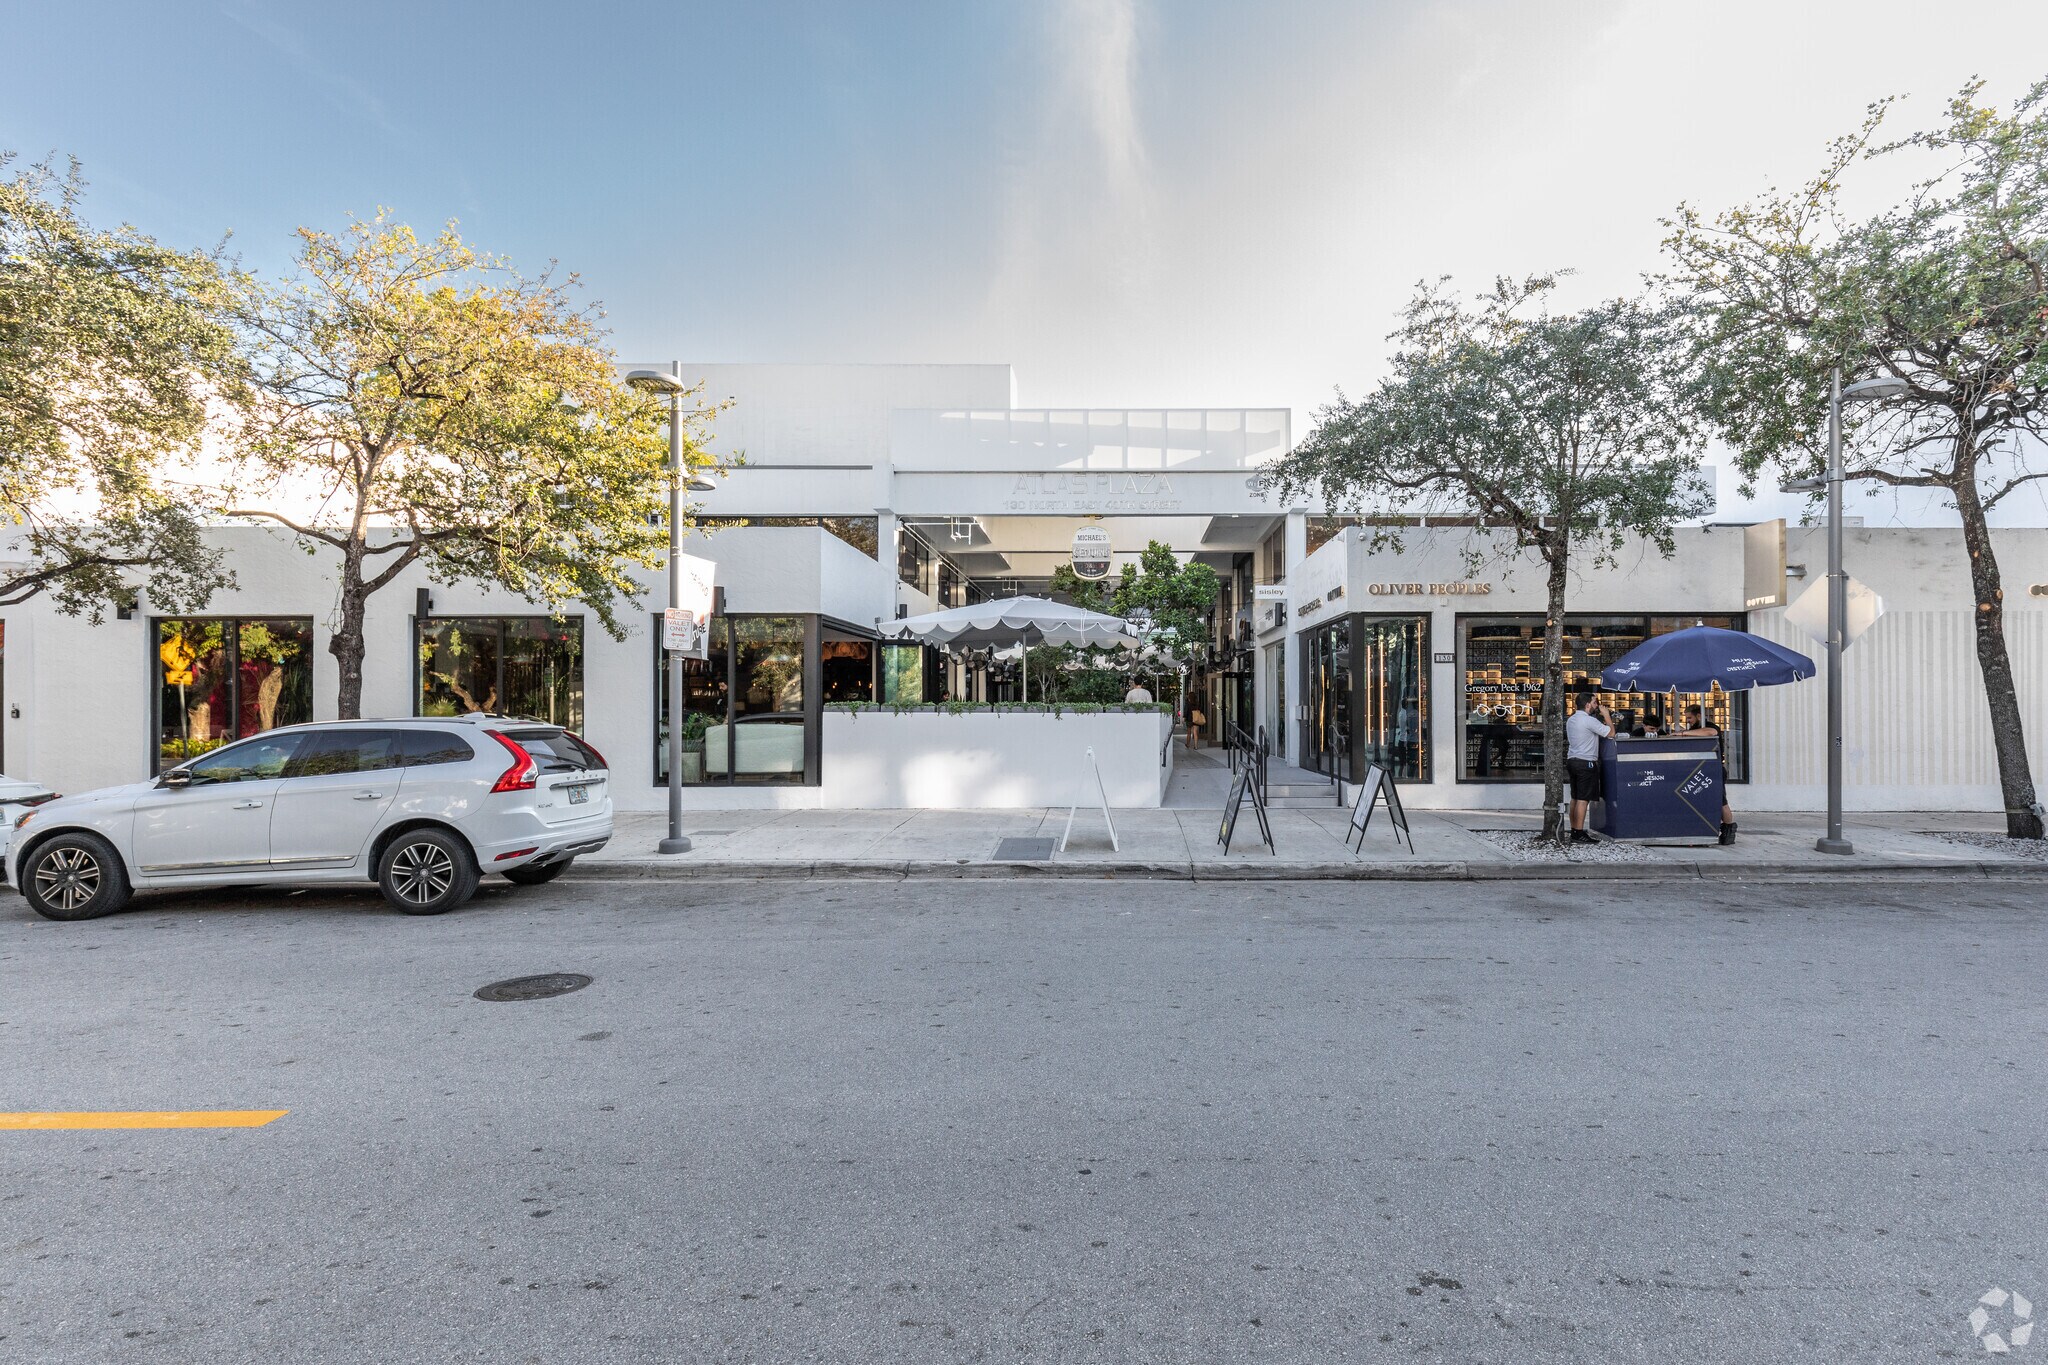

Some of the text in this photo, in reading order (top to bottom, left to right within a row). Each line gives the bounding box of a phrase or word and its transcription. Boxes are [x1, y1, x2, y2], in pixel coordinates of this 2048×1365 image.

[1012, 473, 1174, 495] ATLAS PLAZA
[1029, 500, 1069, 510] NORTH
[1073, 500, 1102, 510] EAST
[1139, 500, 1182, 510] STREET
[1367, 582, 1492, 596] OLIVER PEOPLES
[668, 619, 691, 627] VALET
[1464, 683, 1542, 694] Gregory Peck 1962
[1681, 770, 1706, 794] VALET
[1700, 776, 1713, 789] $5
